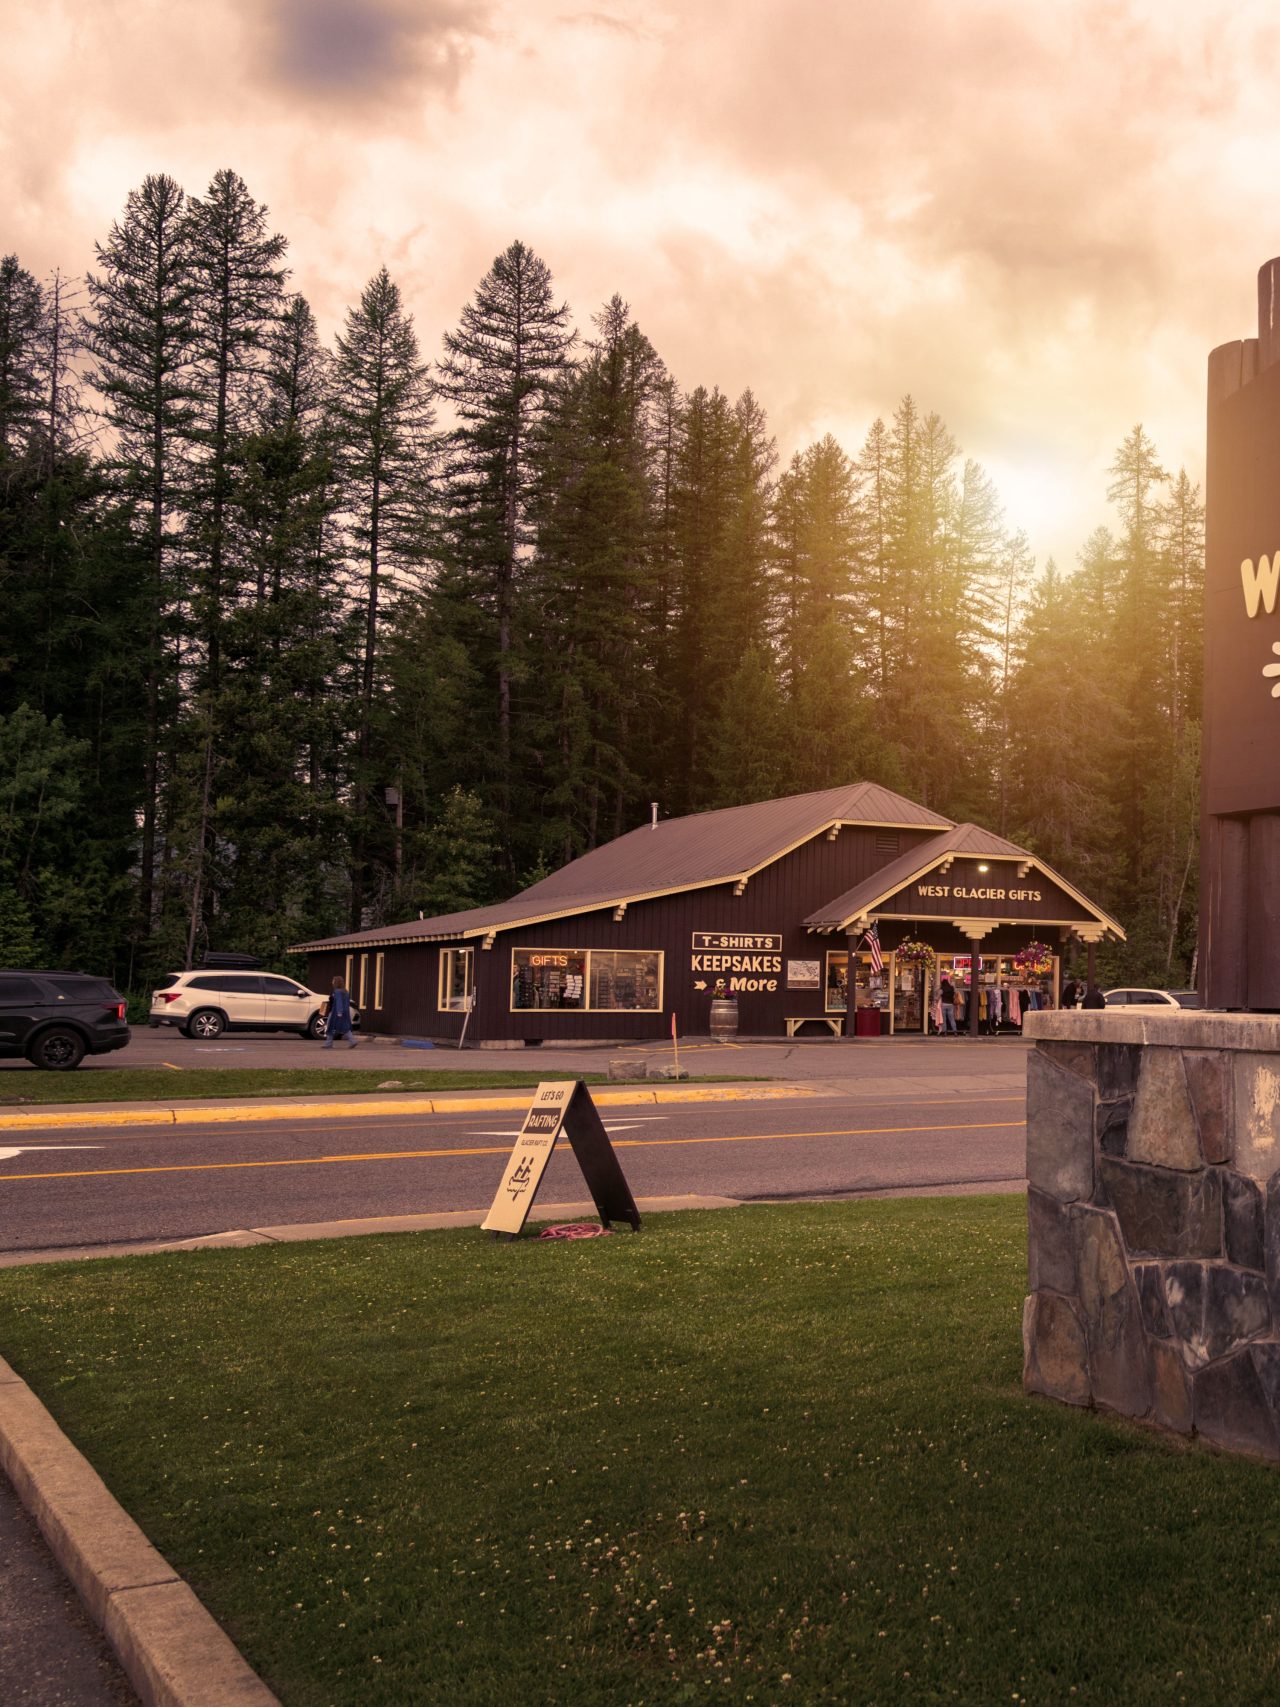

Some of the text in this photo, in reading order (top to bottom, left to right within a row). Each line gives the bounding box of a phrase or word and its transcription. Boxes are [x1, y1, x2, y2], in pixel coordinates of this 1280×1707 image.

[918, 885, 1042, 901] WEST GLACIER GIFTS
[702, 936, 773, 948] T-SHIRTS
[532, 955, 568, 966] GIFTS
[691, 955, 782, 972] KEEPSAKES
[730, 977, 778, 992] More
[541, 1090, 564, 1101] LET'S GO
[528, 1114, 559, 1128] RAFTING
